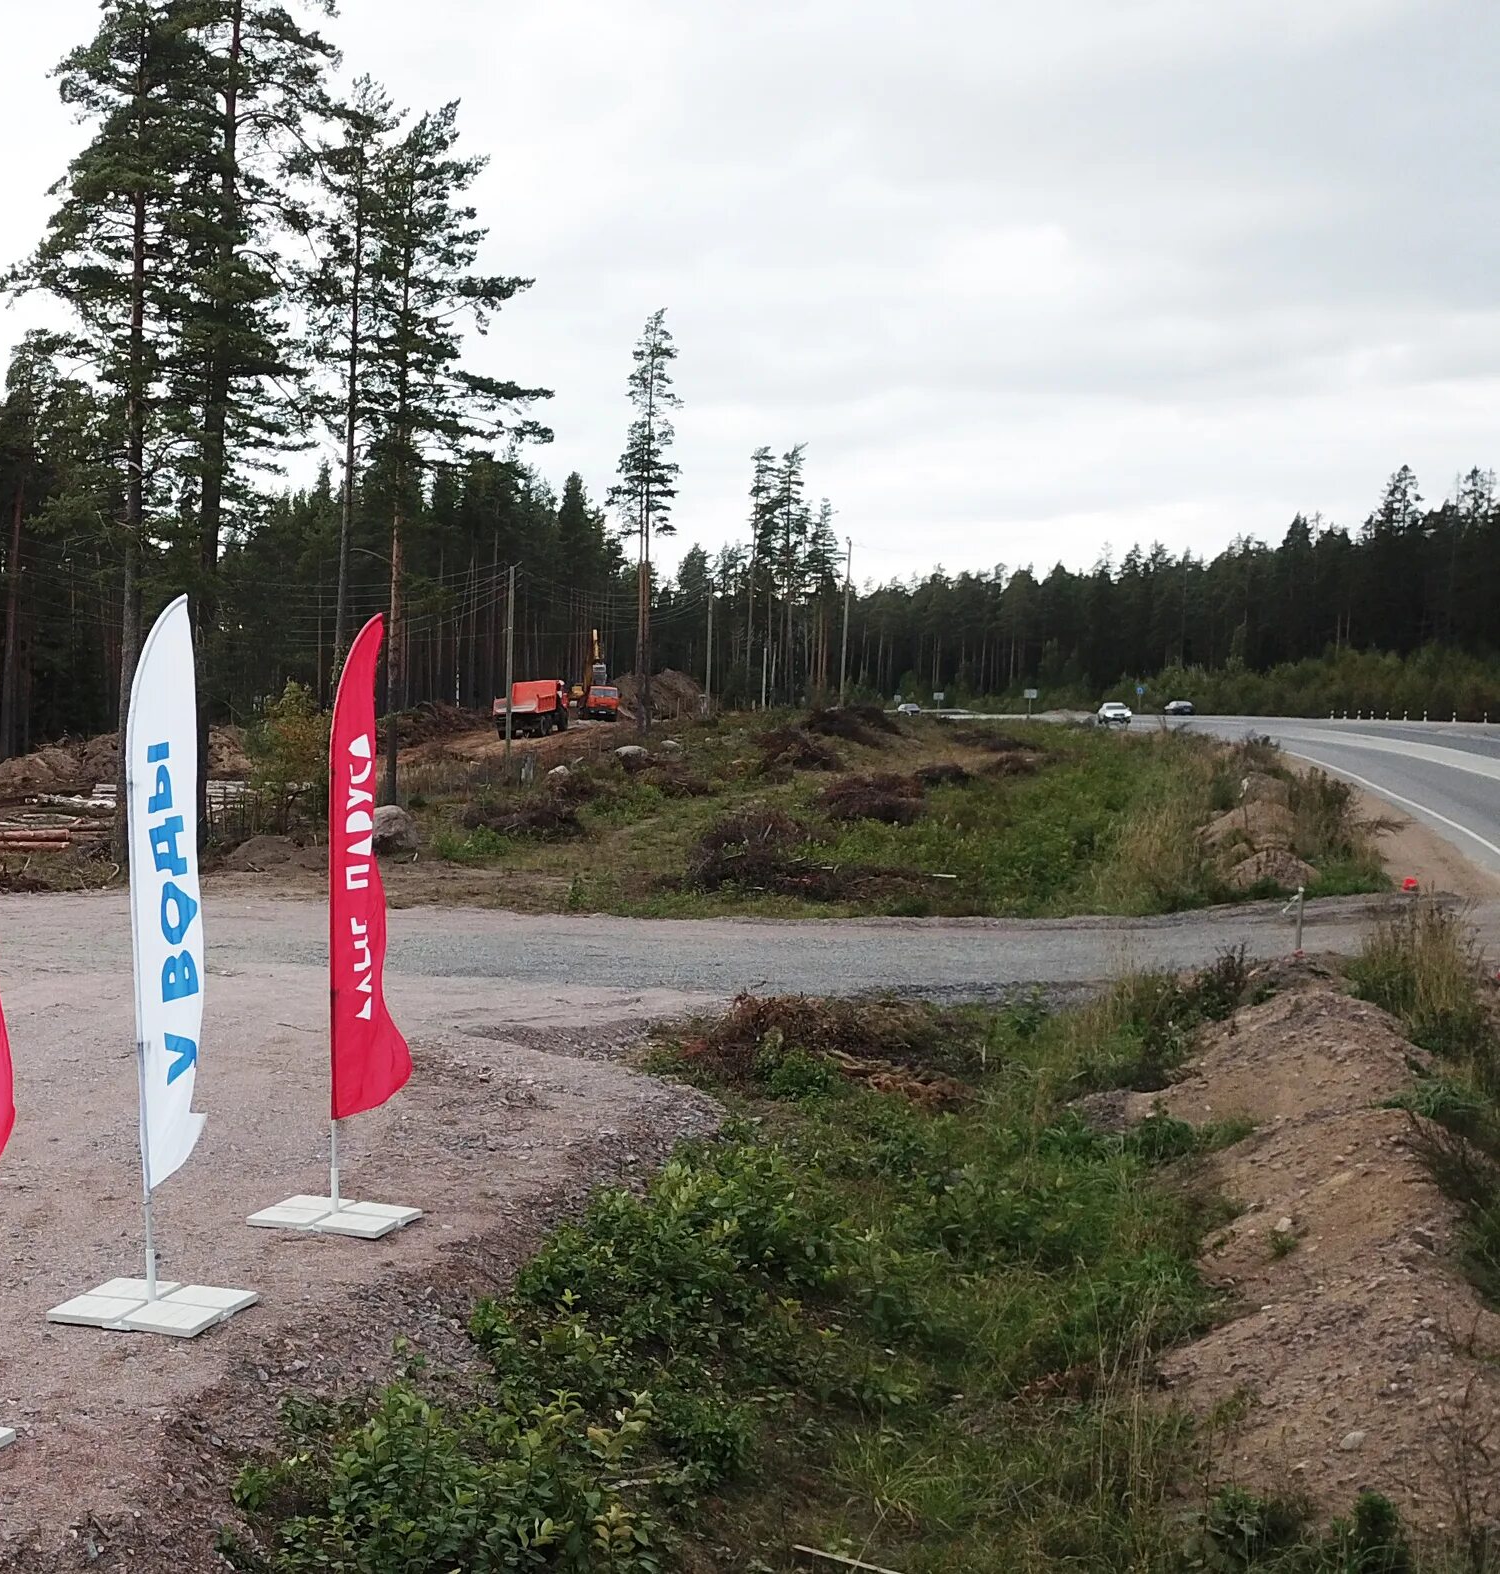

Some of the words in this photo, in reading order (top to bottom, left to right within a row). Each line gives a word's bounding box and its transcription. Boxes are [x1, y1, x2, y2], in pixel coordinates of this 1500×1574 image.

[147, 741, 200, 1003] ВОДЫ
[345, 733, 373, 890] ПАРУСА
[163, 1032, 198, 1085] У
